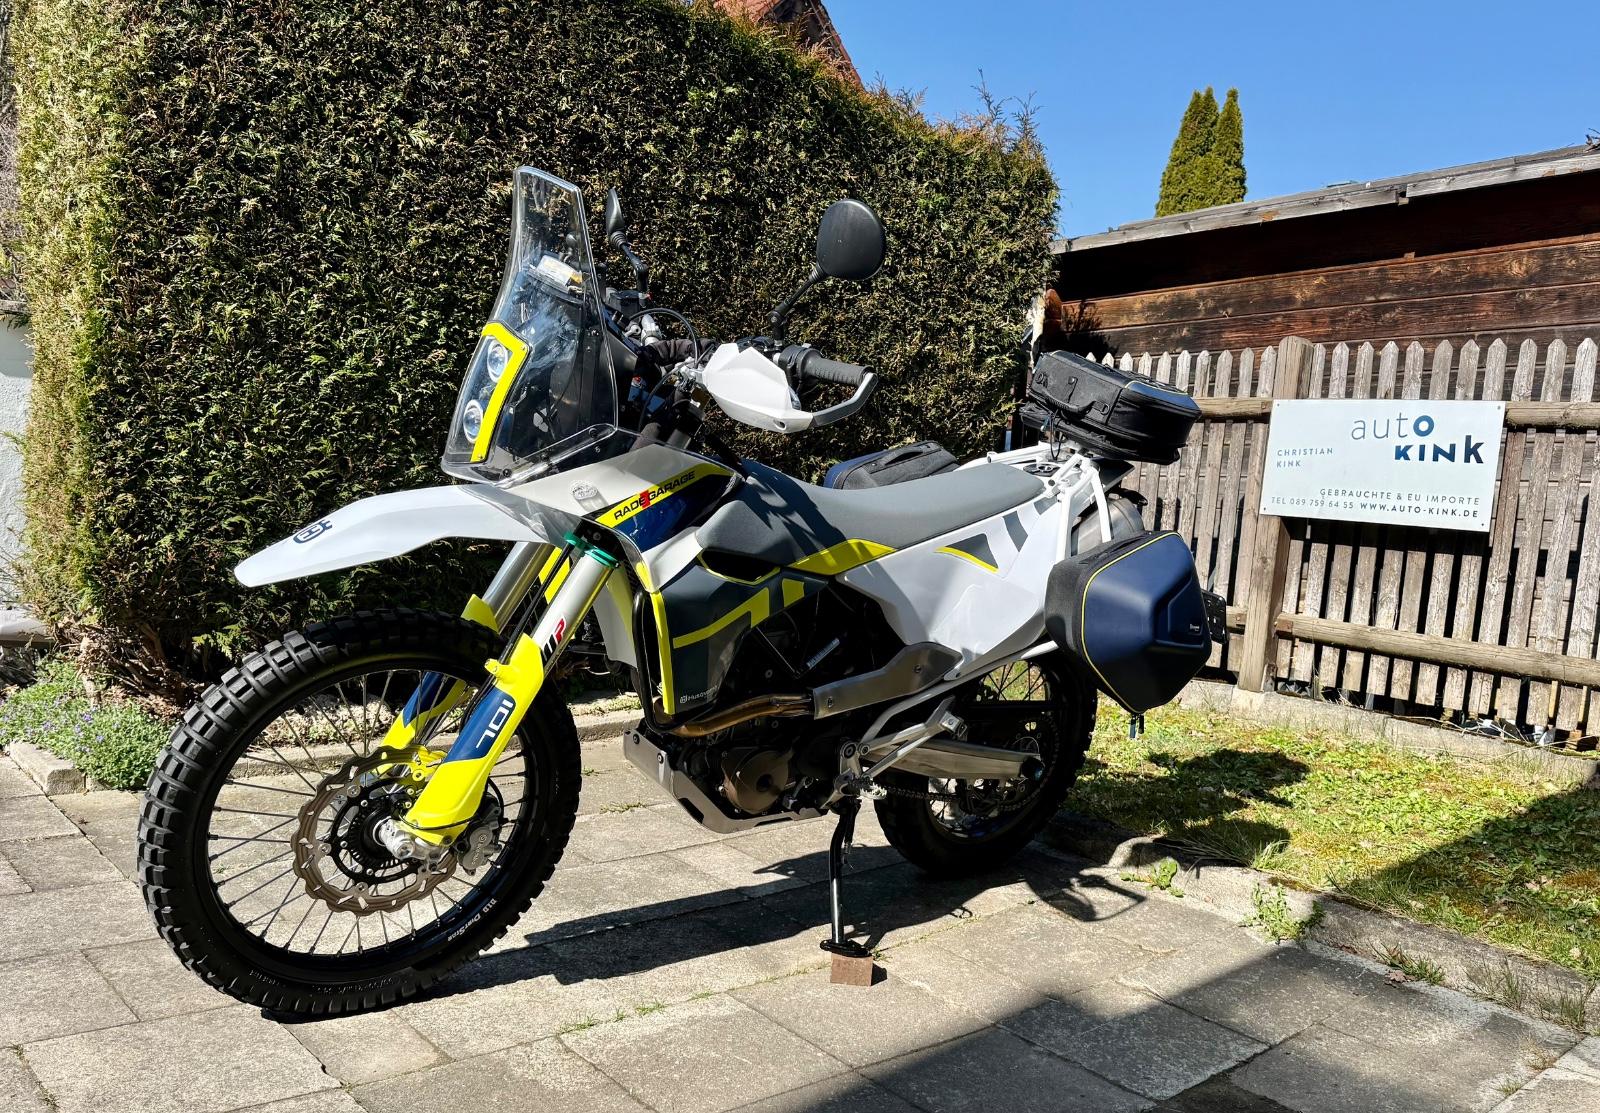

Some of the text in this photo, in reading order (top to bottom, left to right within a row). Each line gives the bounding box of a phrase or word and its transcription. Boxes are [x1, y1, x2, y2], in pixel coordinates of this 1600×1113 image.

[1351, 412, 1435, 440] auto
[1277, 447, 1333, 457] CHRISTIAN
[1276, 459, 1301, 468] KINK
[648, 470, 696, 501] GARAGE
[1271, 496, 1287, 505] TEL
[1310, 499, 1325, 507] 759
[1328, 500, 1339, 508] 64
[1343, 501, 1354, 509] 55
[1360, 502, 1478, 518] WWW.AUTO-KINK.DE
[1320, 488, 1480, 506] GEBRAUCHTE & EU IMPORTE
[475, 698, 514, 749] 701
